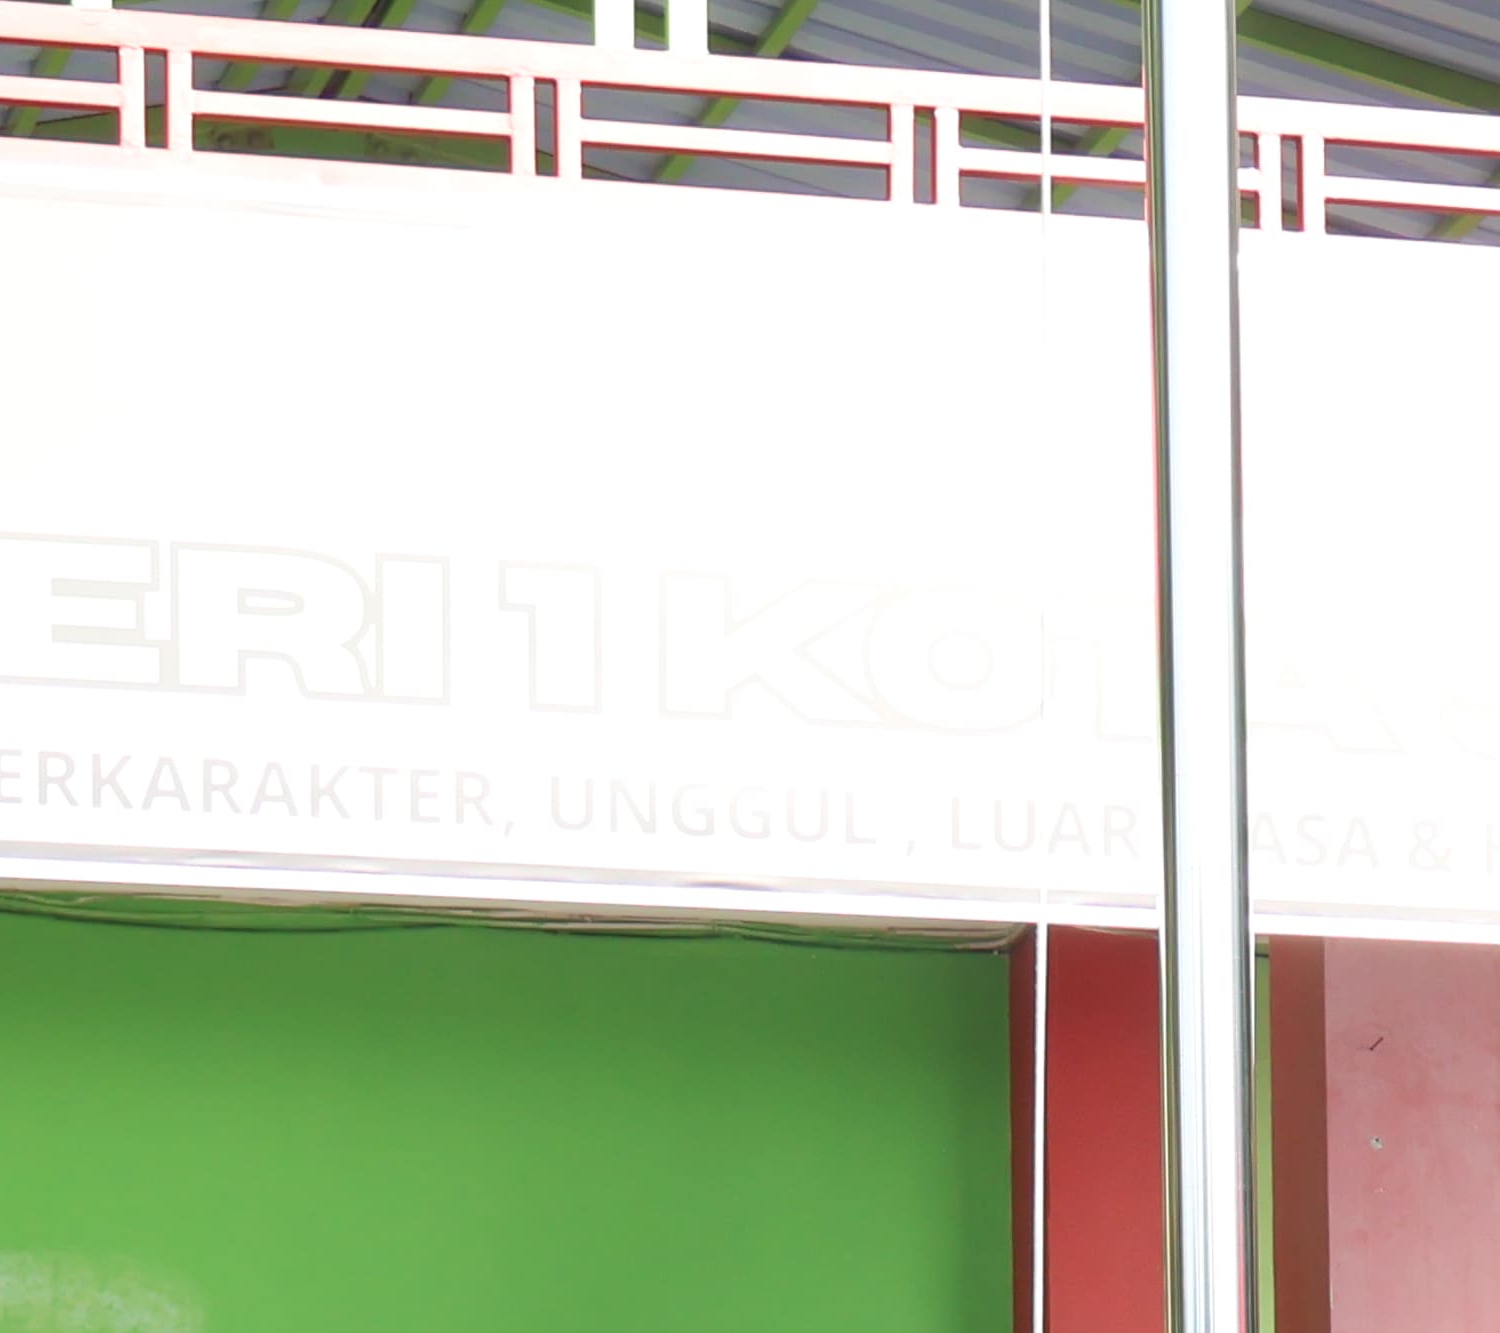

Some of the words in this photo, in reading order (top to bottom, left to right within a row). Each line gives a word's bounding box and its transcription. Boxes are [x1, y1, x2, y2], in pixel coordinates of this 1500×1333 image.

[497, 558, 603, 715] 1
[951, 796, 1141, 858] LUAR
[1250, 811, 1380, 870] ASA
